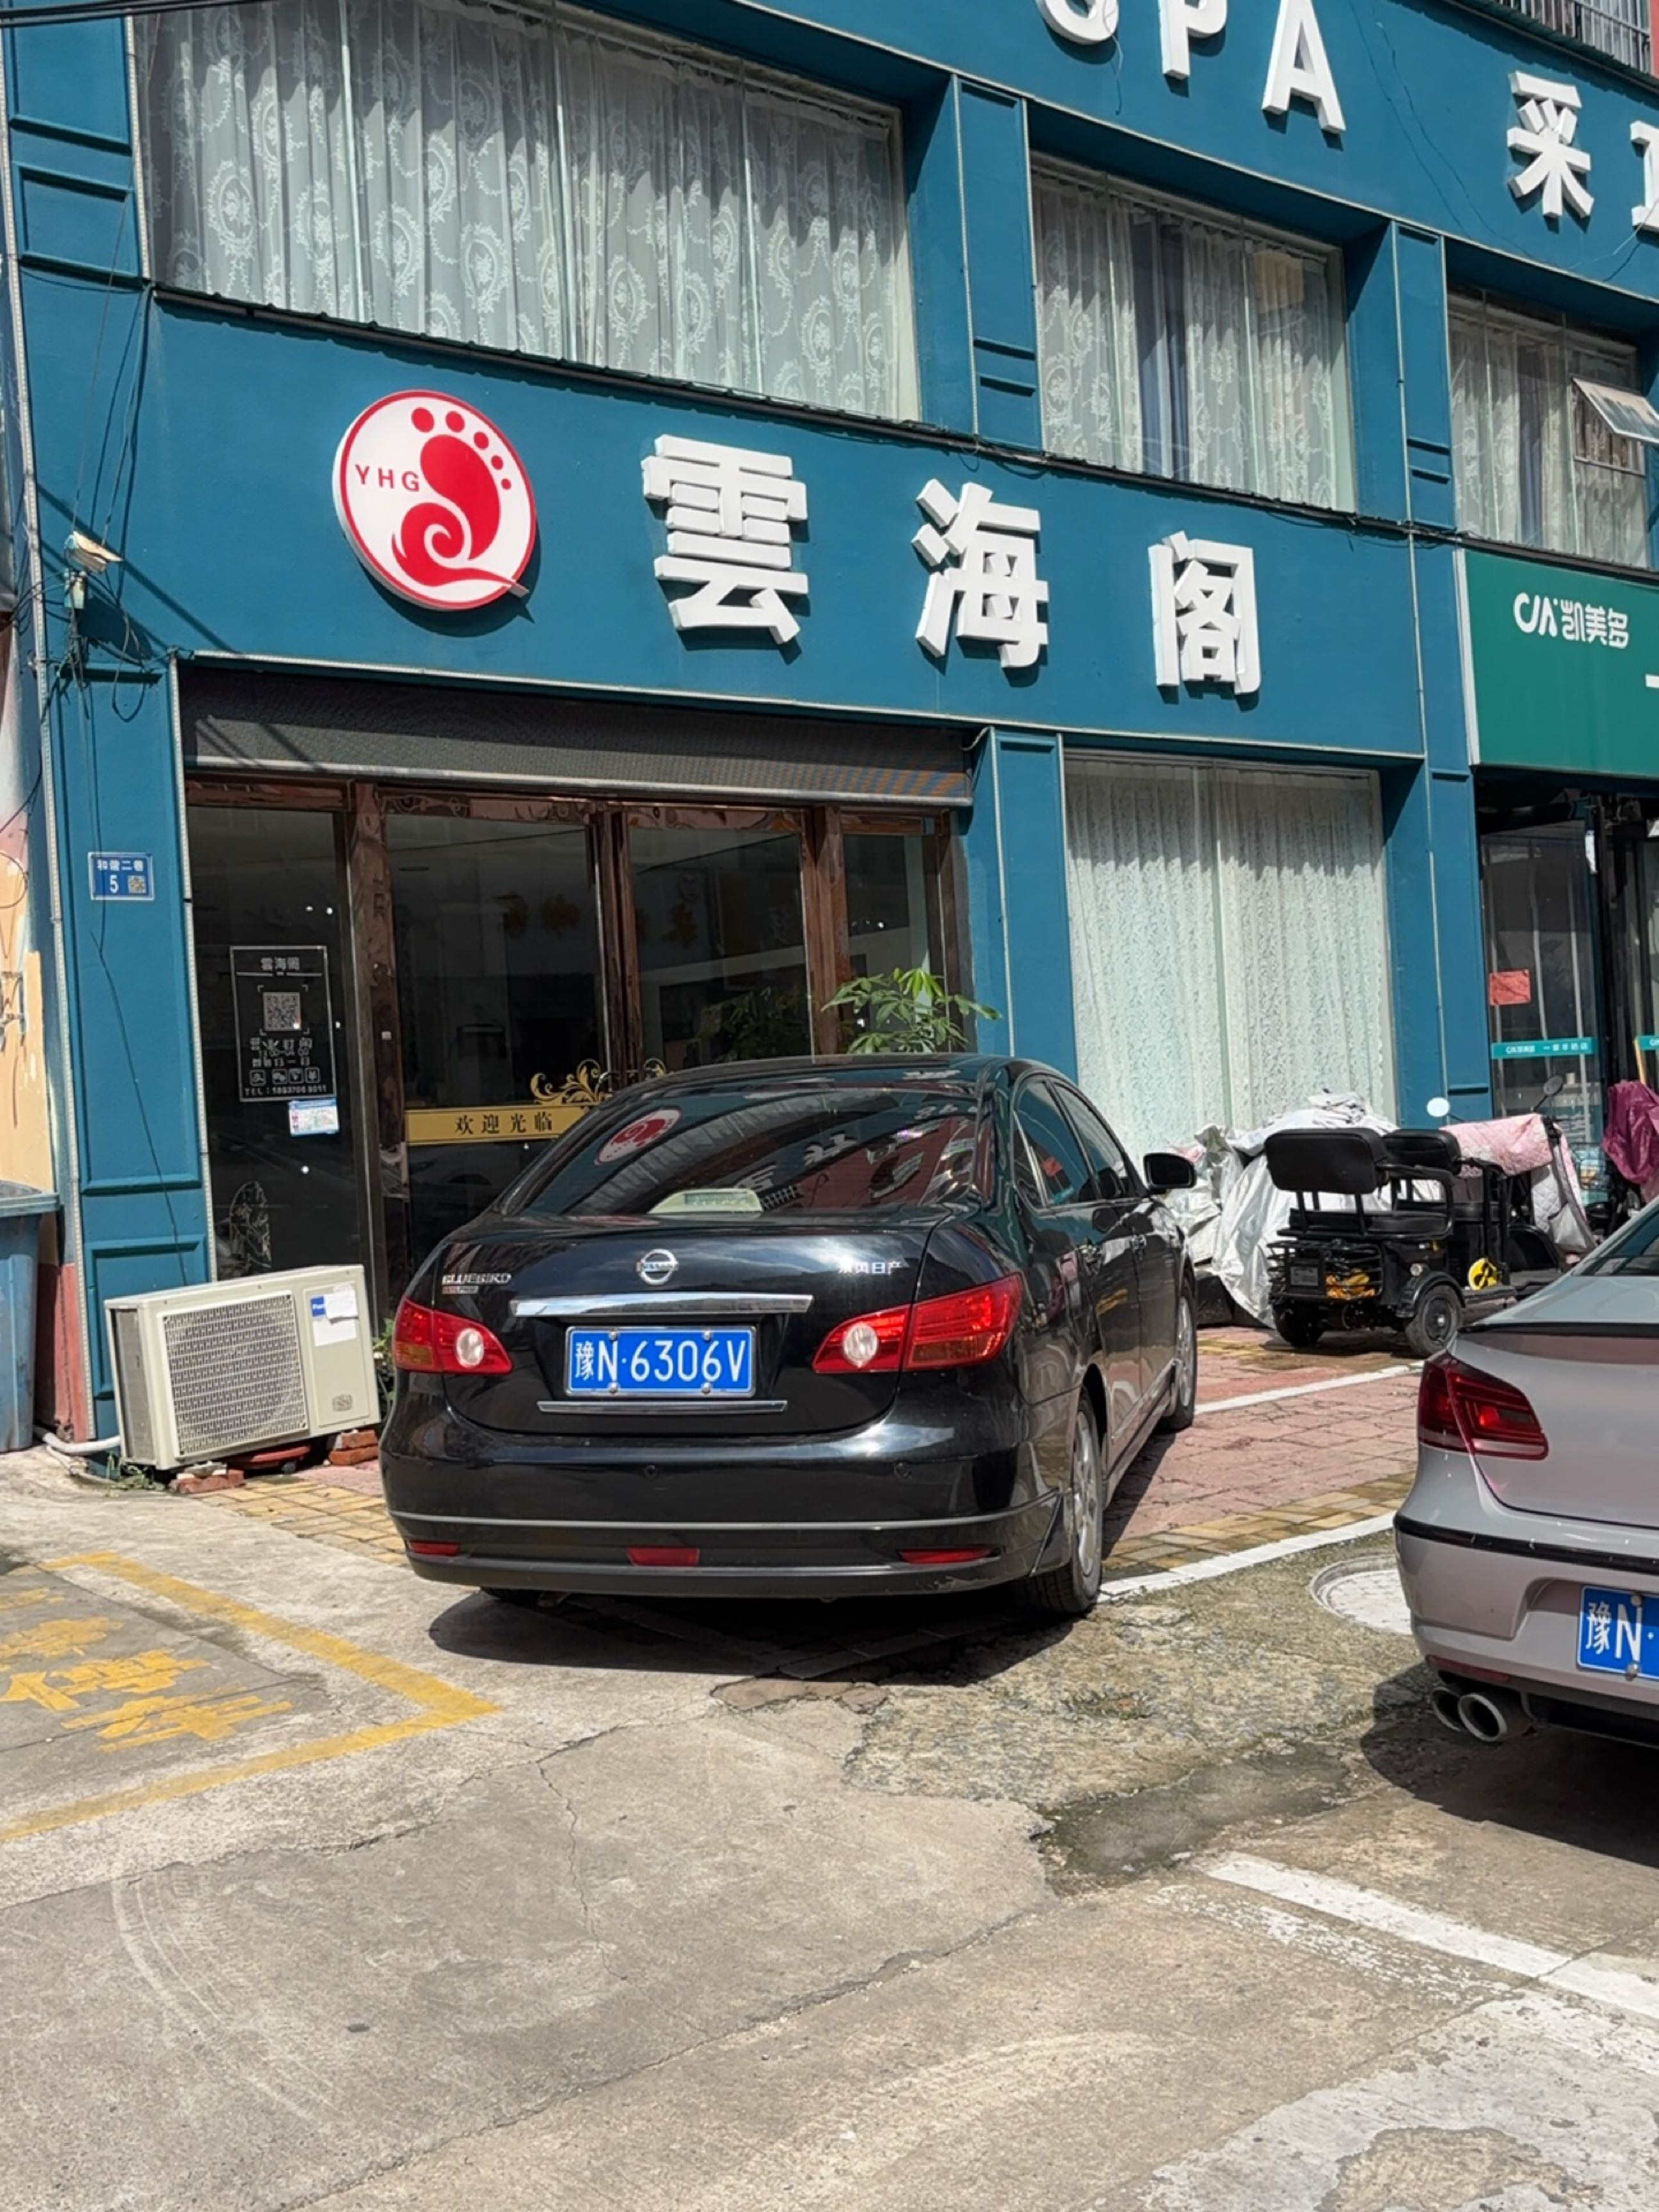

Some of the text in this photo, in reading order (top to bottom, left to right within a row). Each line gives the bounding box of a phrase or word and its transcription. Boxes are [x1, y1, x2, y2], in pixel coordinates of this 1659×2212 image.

[355, 463, 419, 492] YHG
[1560, 599, 1629, 649] 凯美多
[109, 875, 119, 894] 5
[455, 1111, 552, 1135] 欢迎光临
